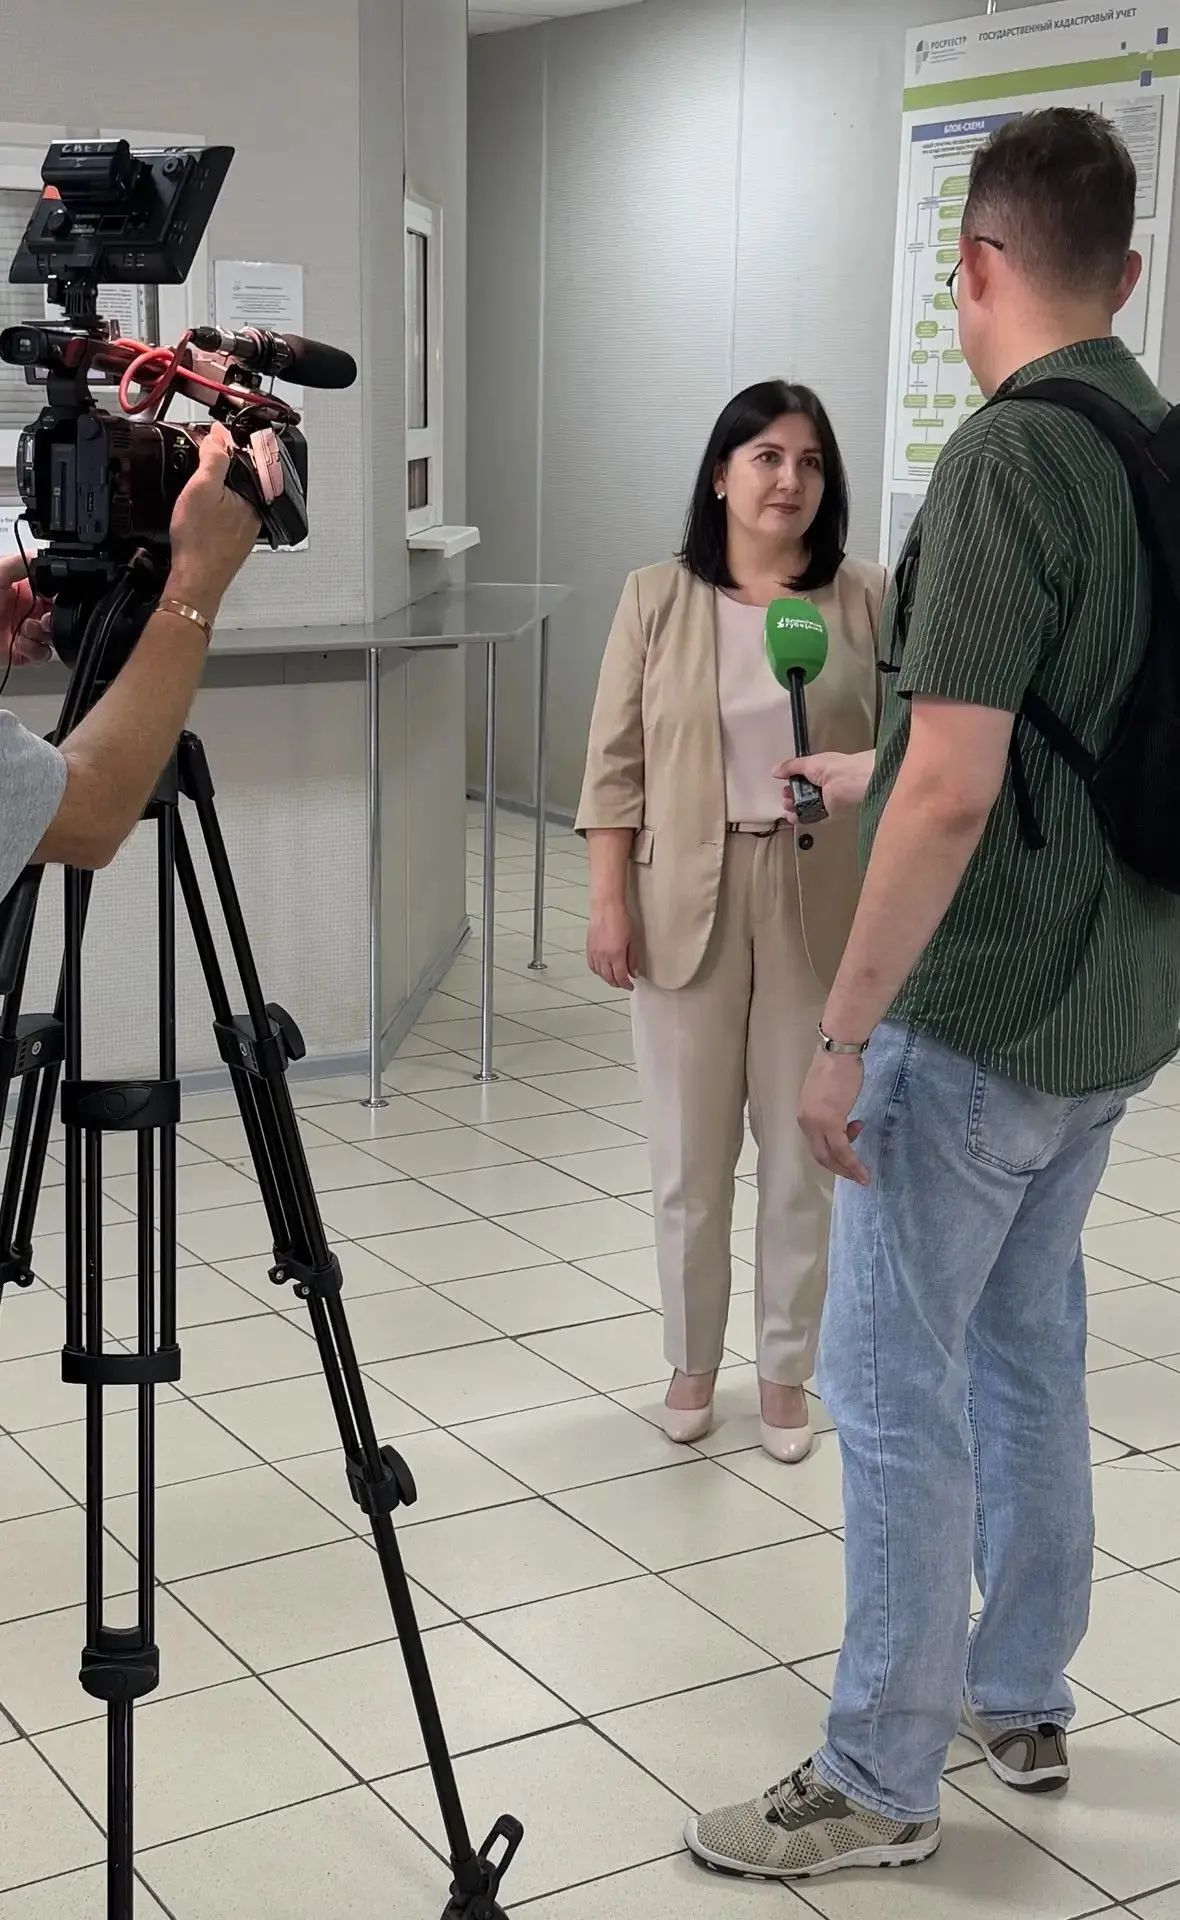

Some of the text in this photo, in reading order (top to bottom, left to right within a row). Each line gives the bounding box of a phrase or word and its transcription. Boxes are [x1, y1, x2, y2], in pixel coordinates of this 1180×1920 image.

[979, 8, 1137, 41] ГОСУДАРСТВЕННЫЙ КАДАСТРОВЫЙ УЧЕТ
[930, 36, 967, 49] РОСРЕЕСТР
[943, 120, 985, 134] БЛОК-СХЕМА
